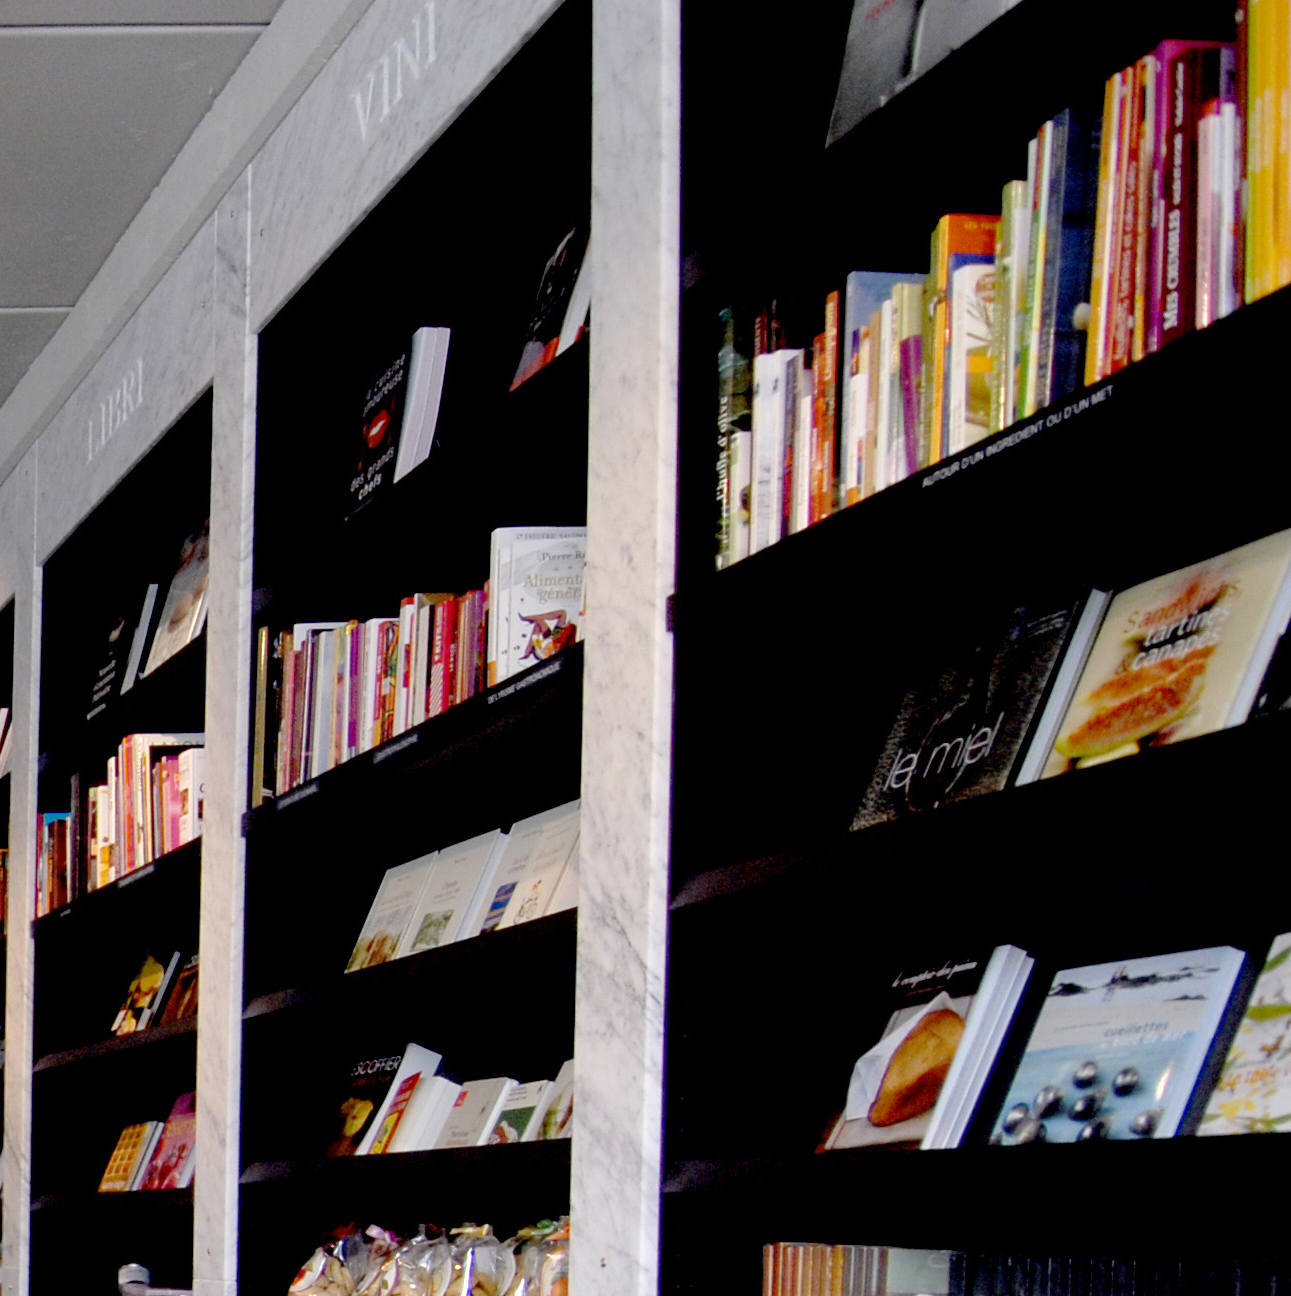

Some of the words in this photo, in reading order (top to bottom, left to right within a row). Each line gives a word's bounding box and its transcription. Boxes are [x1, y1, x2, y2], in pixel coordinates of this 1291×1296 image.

[349, 2, 438, 143] VINI
[86, 358, 145, 461] LIBRI
[358, 473, 382, 500] chefs
[922, 461, 960, 488] AUTOUR
[1046, 413, 1062, 427] OU
[541, 552, 572, 561] Pierre
[883, 747, 919, 793] le
[924, 713, 1006, 782] miel
[1104, 1021, 1170, 1038] cueillettes
